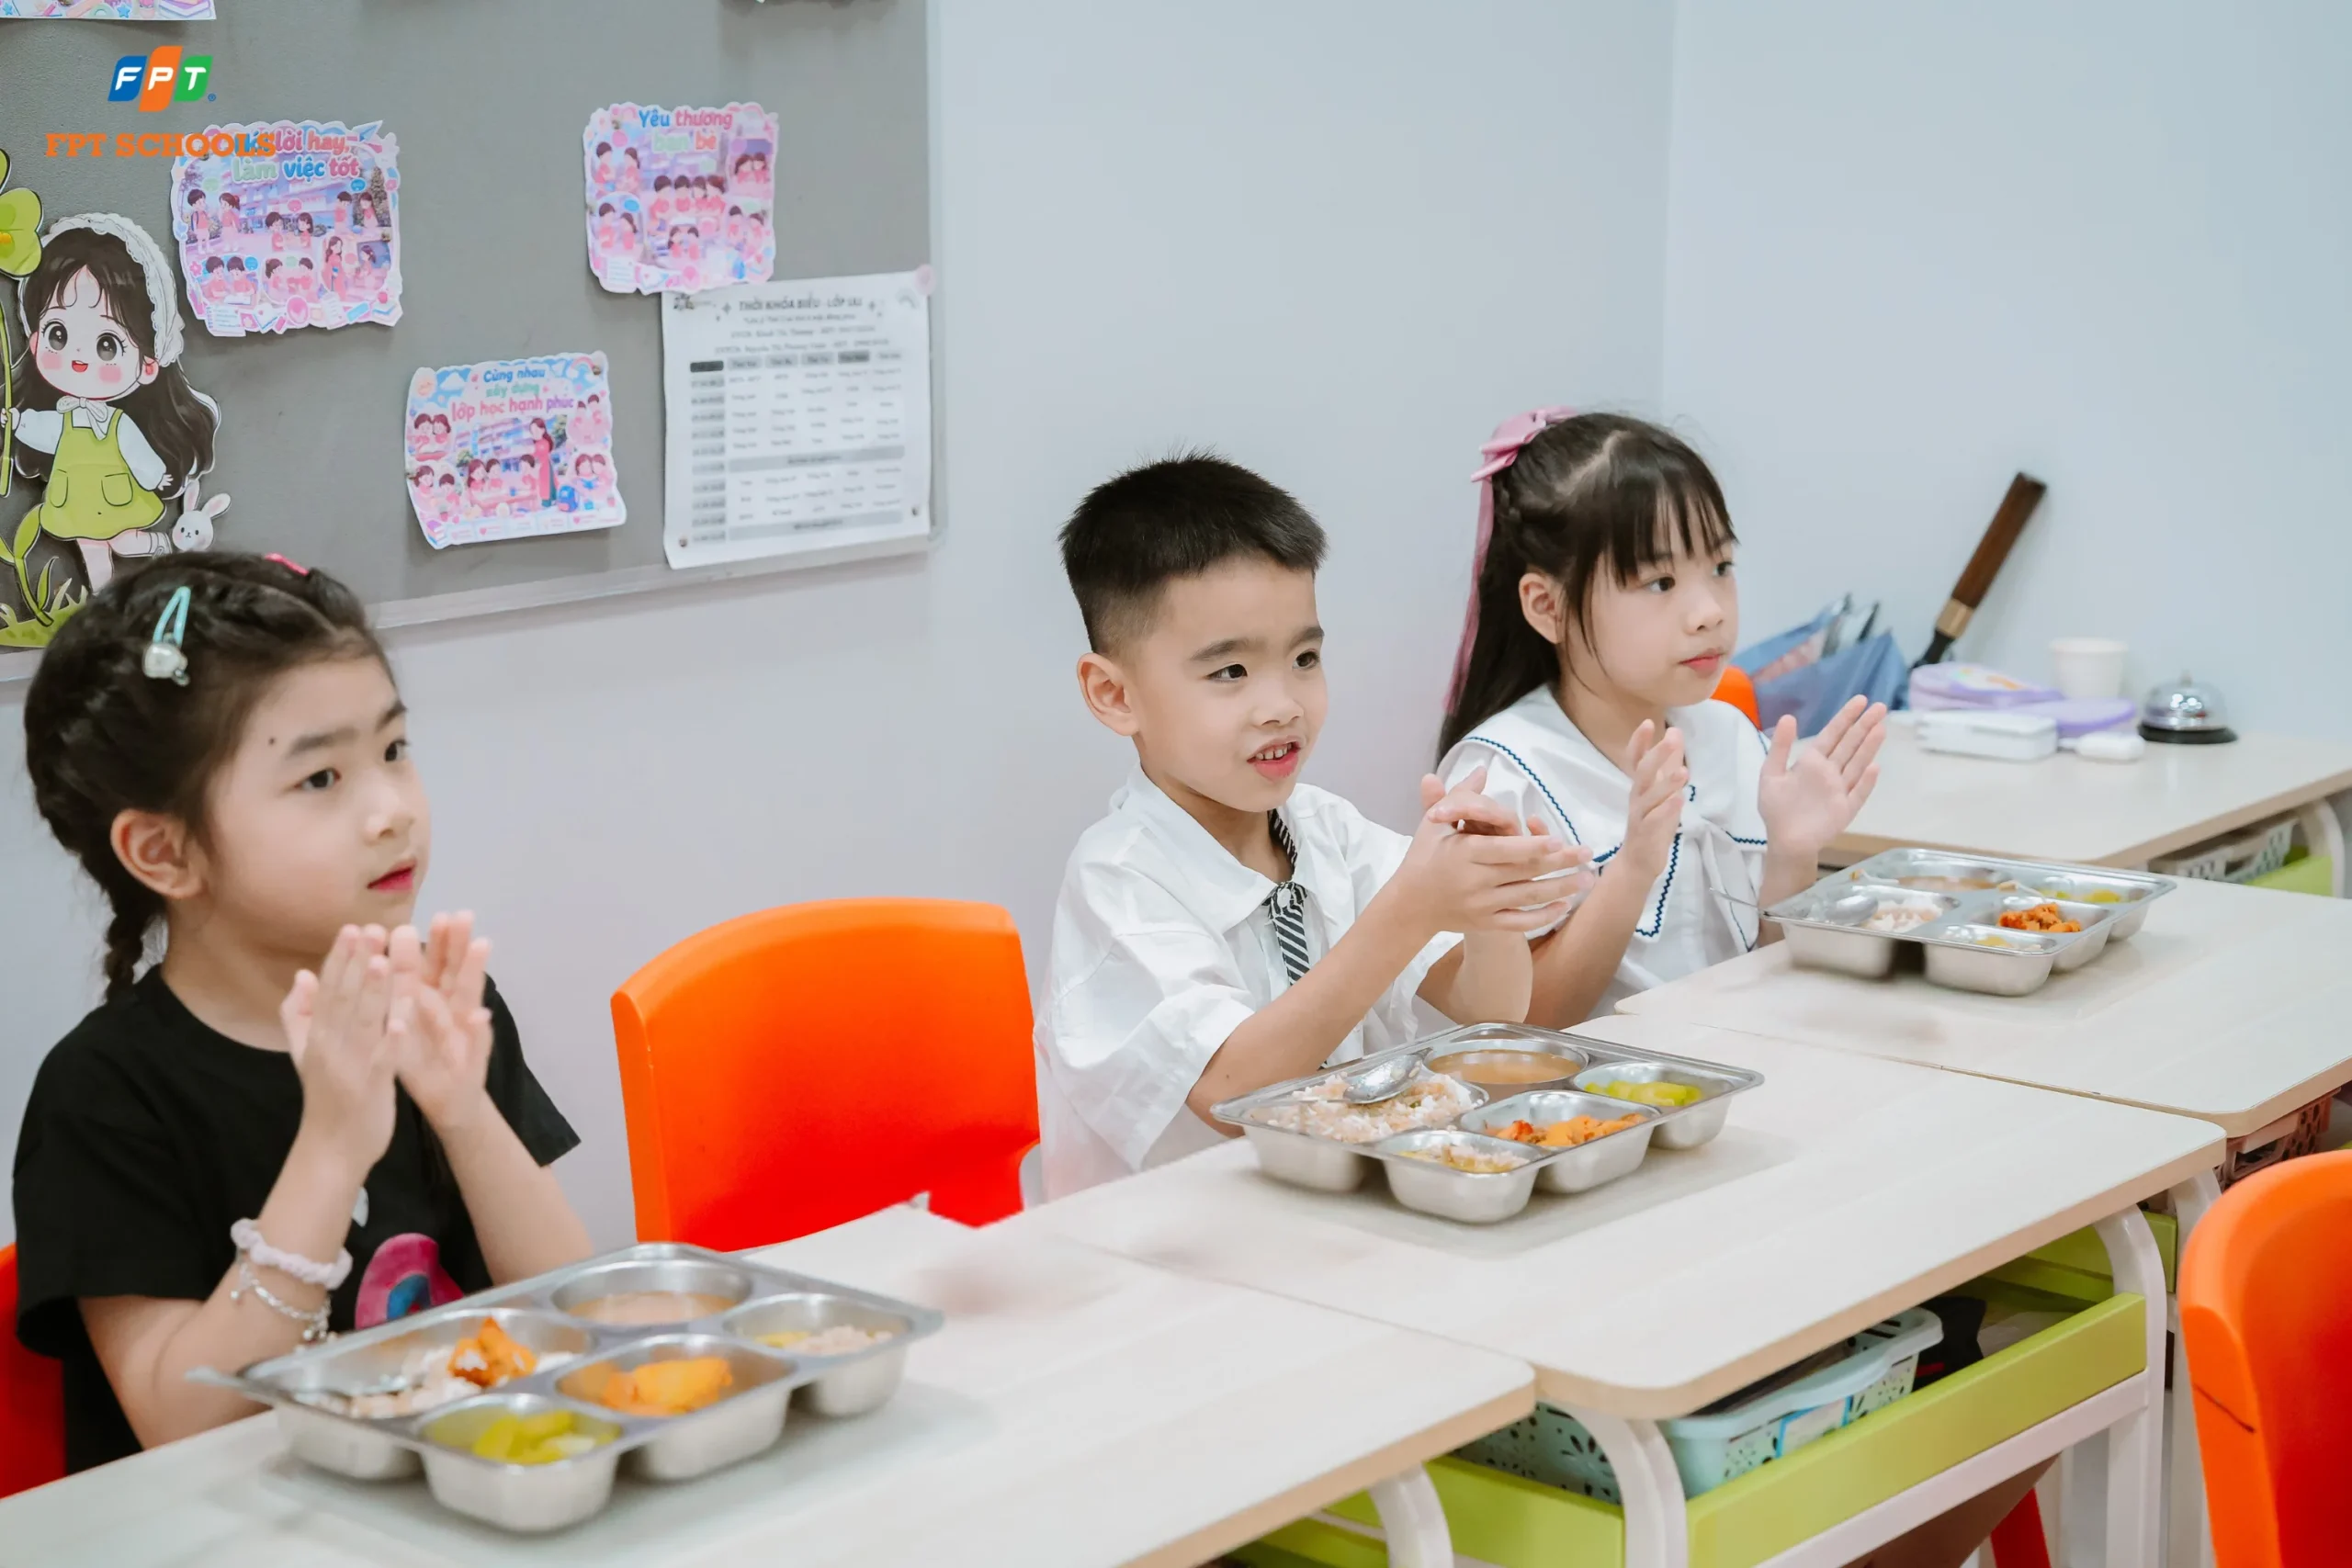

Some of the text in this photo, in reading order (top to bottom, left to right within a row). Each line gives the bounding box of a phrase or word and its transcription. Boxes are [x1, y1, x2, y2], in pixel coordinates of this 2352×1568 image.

[639, 107, 732, 130] Yêu thương
[284, 155, 324, 182] việc
[329, 155, 359, 177] tốt
[483, 367, 546, 383] Cùng nhau
[452, 400, 476, 423] lớp
[509, 395, 543, 413] hạnh
